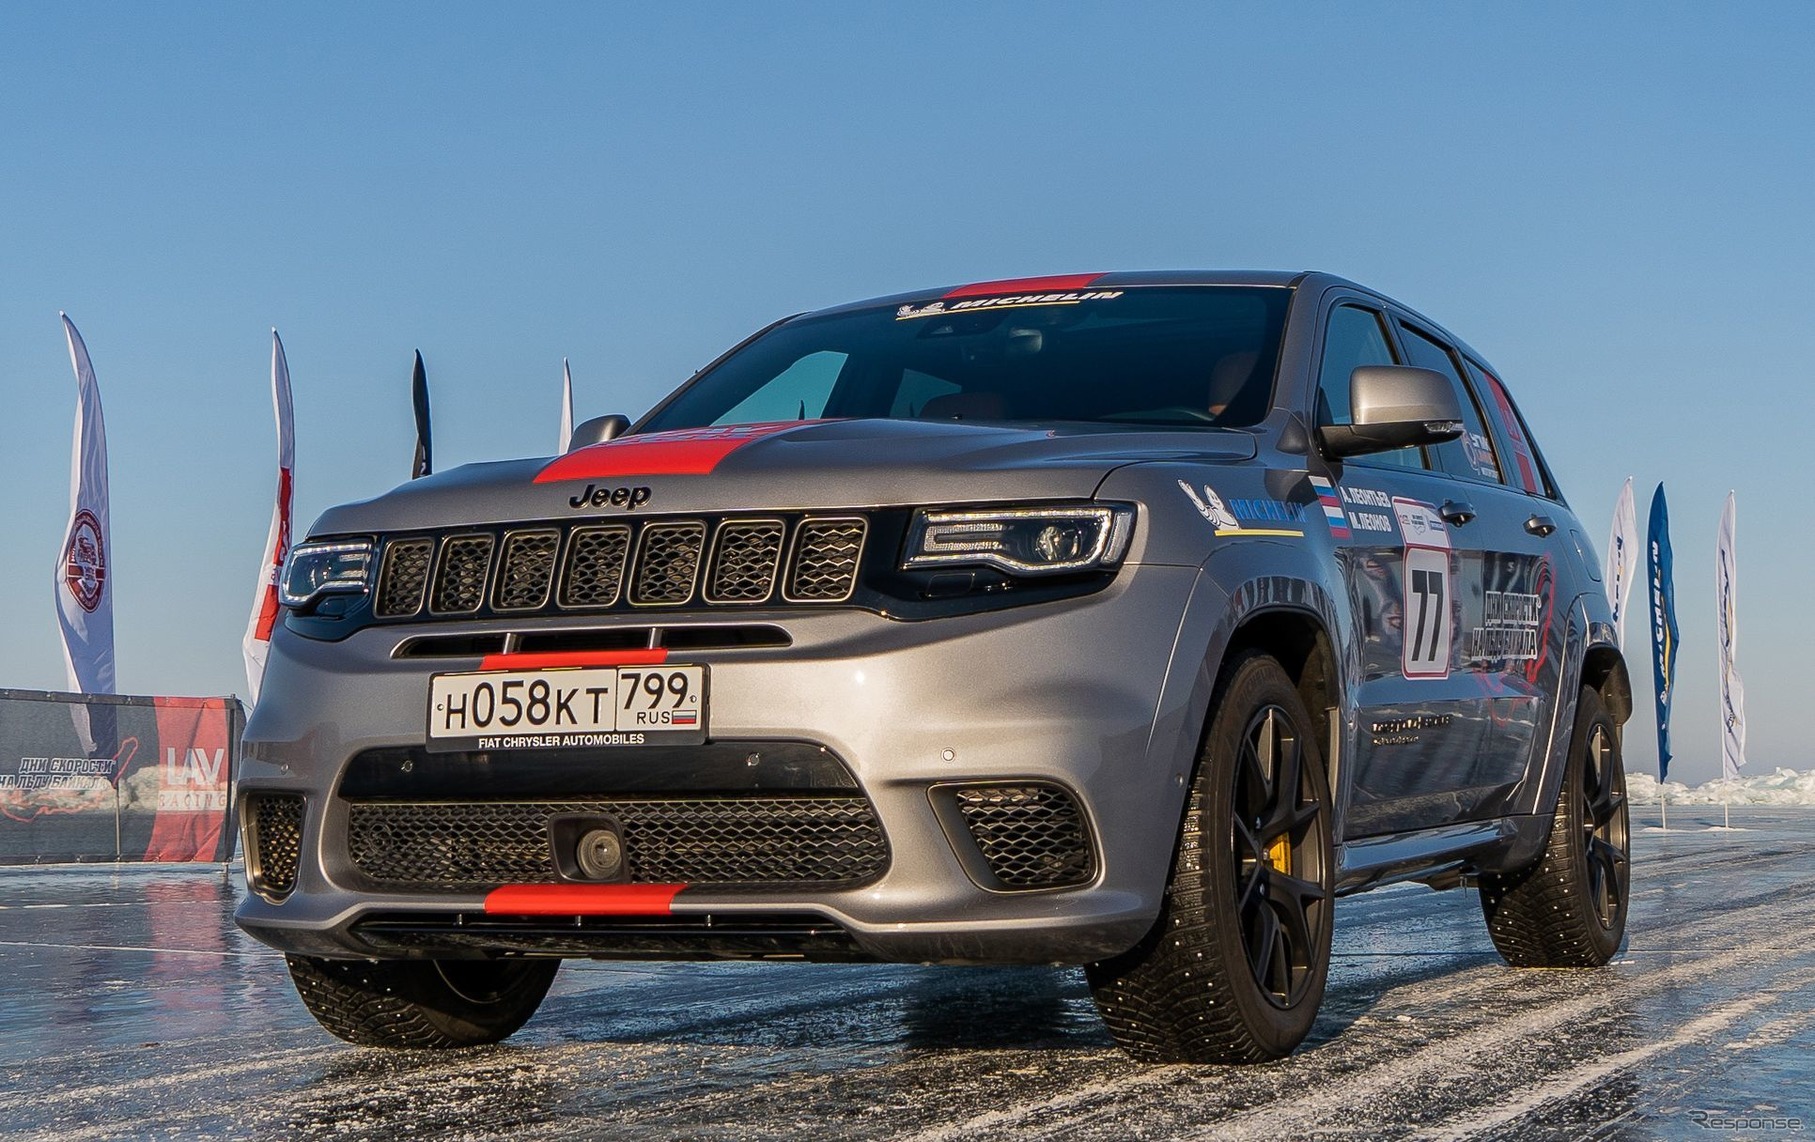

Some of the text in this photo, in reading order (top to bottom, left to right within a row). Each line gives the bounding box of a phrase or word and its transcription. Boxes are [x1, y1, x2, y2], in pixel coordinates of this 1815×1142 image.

[950, 291, 1124, 310] MICHELIN
[568, 484, 652, 511] Jeep
[1411, 569, 1444, 662] 77
[620, 672, 689, 710] 799
[636, 711, 671, 725] RUS
[478, 733, 645, 749] FIAT CHRYSLER AUTOMOBILES
[19, 757, 113, 774] ДНИ СКОРОСТИ
[167, 747, 225, 786] LAV
[17, 774, 50, 791] ЛЬДУ
[158, 793, 227, 807] RACING
